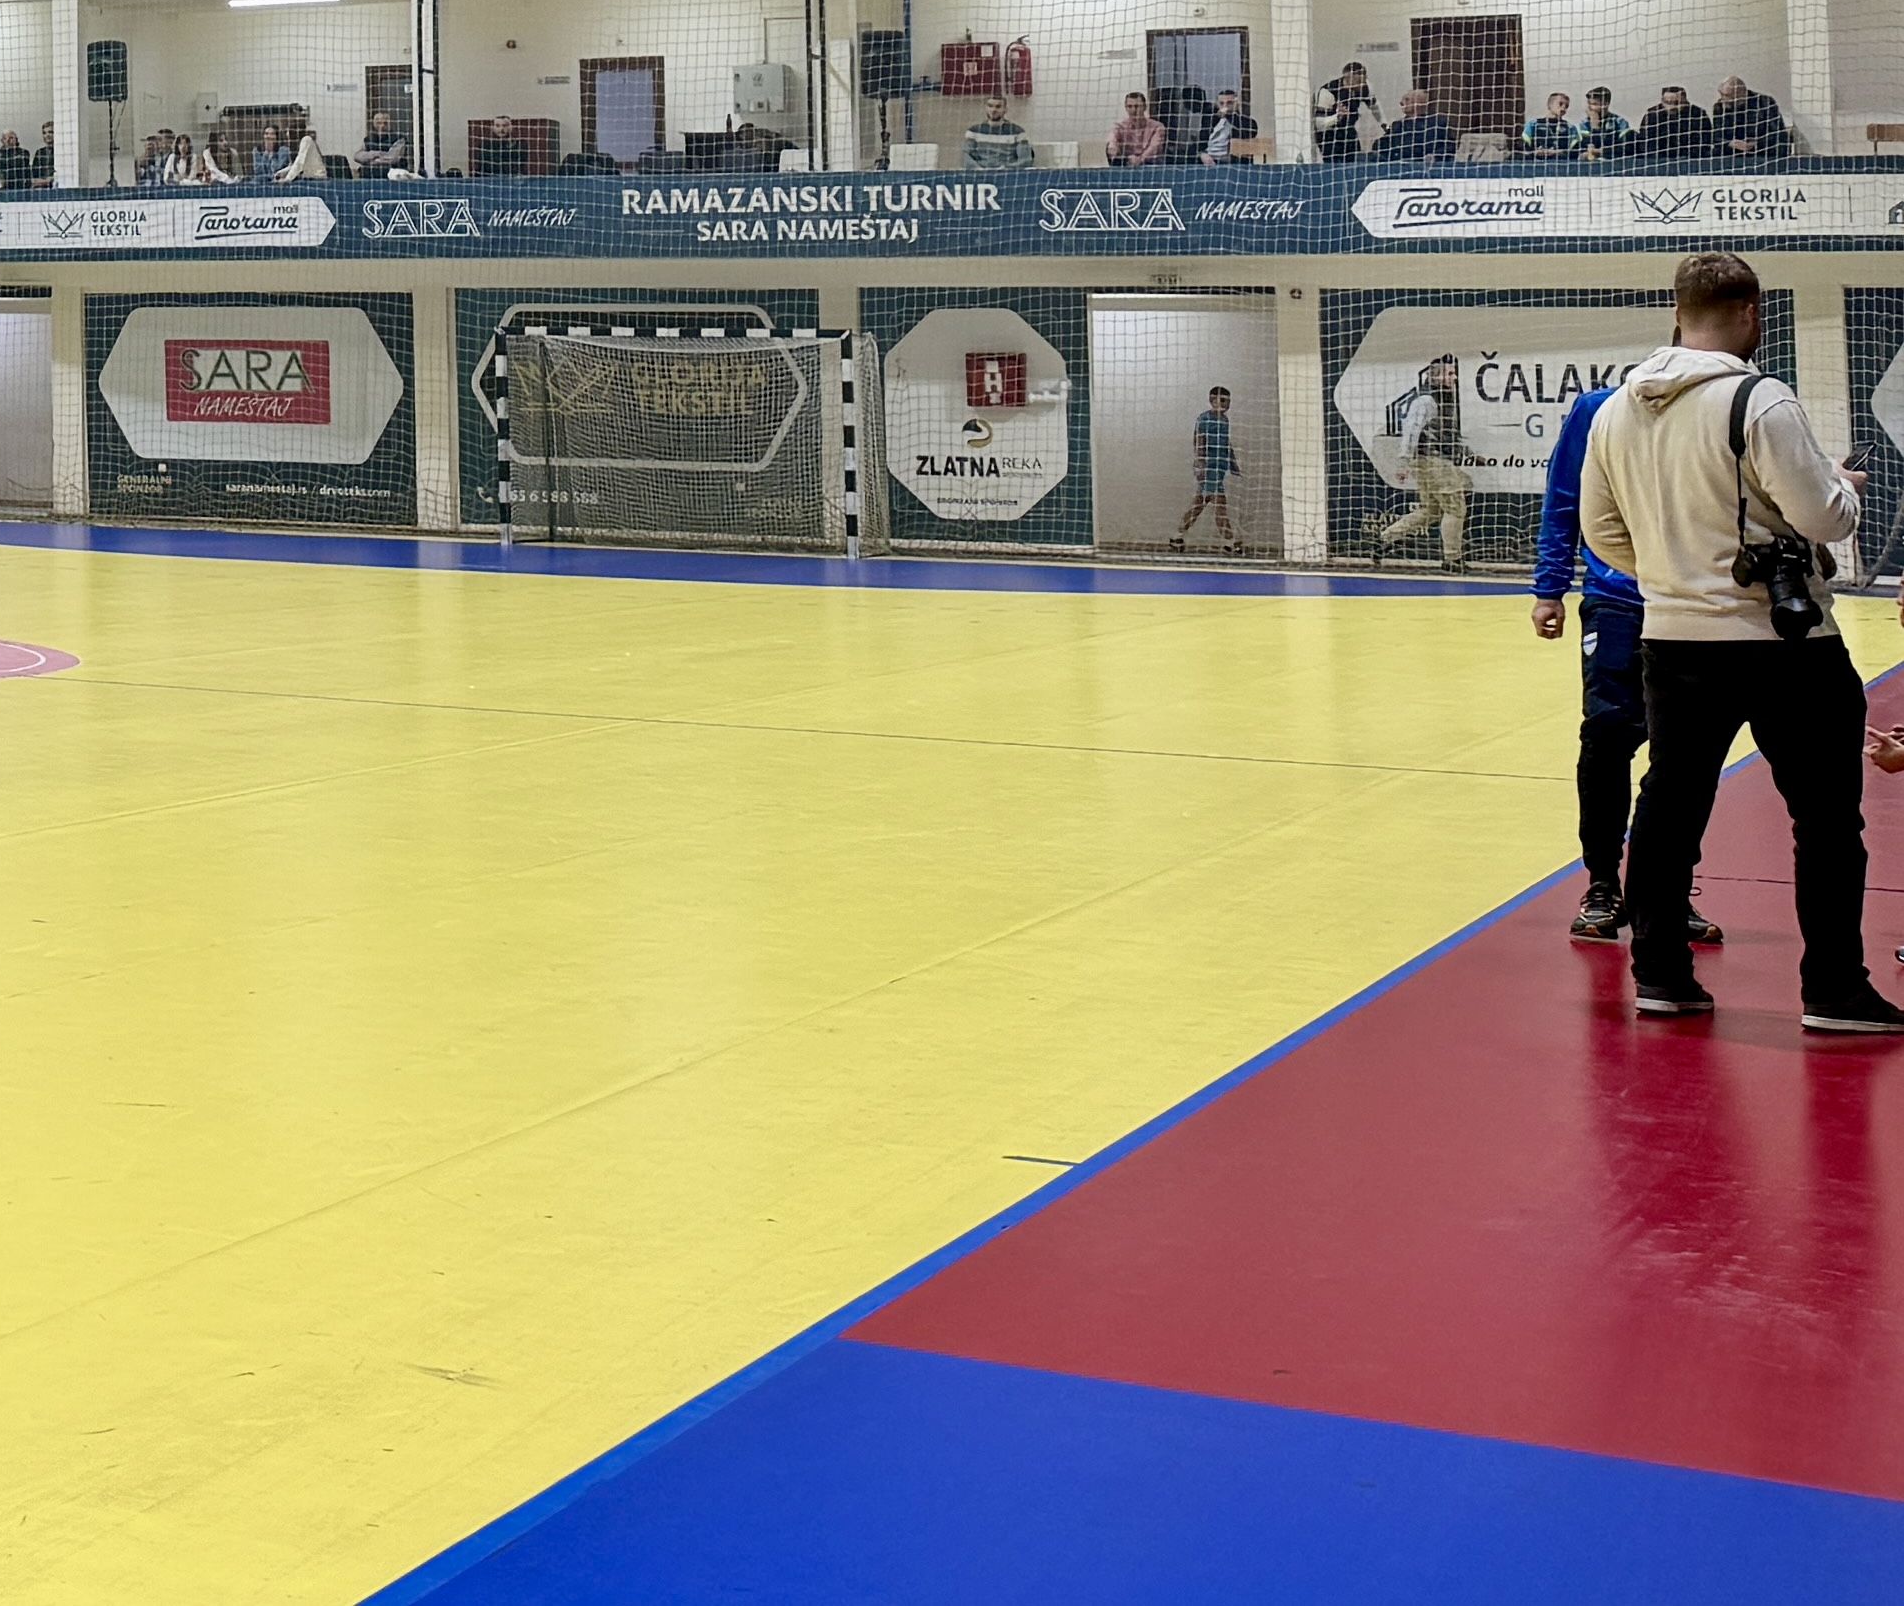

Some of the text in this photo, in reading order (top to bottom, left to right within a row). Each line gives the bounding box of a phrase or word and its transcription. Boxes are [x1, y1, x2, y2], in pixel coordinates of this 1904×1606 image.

[622, 184, 1001, 215] RAMAZANSKI TURNIR
[1394, 187, 1544, 220] Panorama
[1507, 185, 1544, 198] mall
[1712, 189, 1806, 205] GLORIJA
[91, 210, 147, 223] GLORIJA
[195, 206, 299, 233] Panorama
[362, 199, 481, 238] SARA
[1039, 188, 1186, 232] SARA
[1714, 205, 1799, 222] TEKSTIL
[92, 225, 142, 236] TEKSTIL
[696, 215, 919, 245] SARA NAMEŠTAJ
[179, 349, 316, 393] SARA
[193, 393, 293, 417] NAMEŠTAJ
[916, 455, 1043, 478] ZLATNA REKA
[1503, 454, 1525, 469] do
